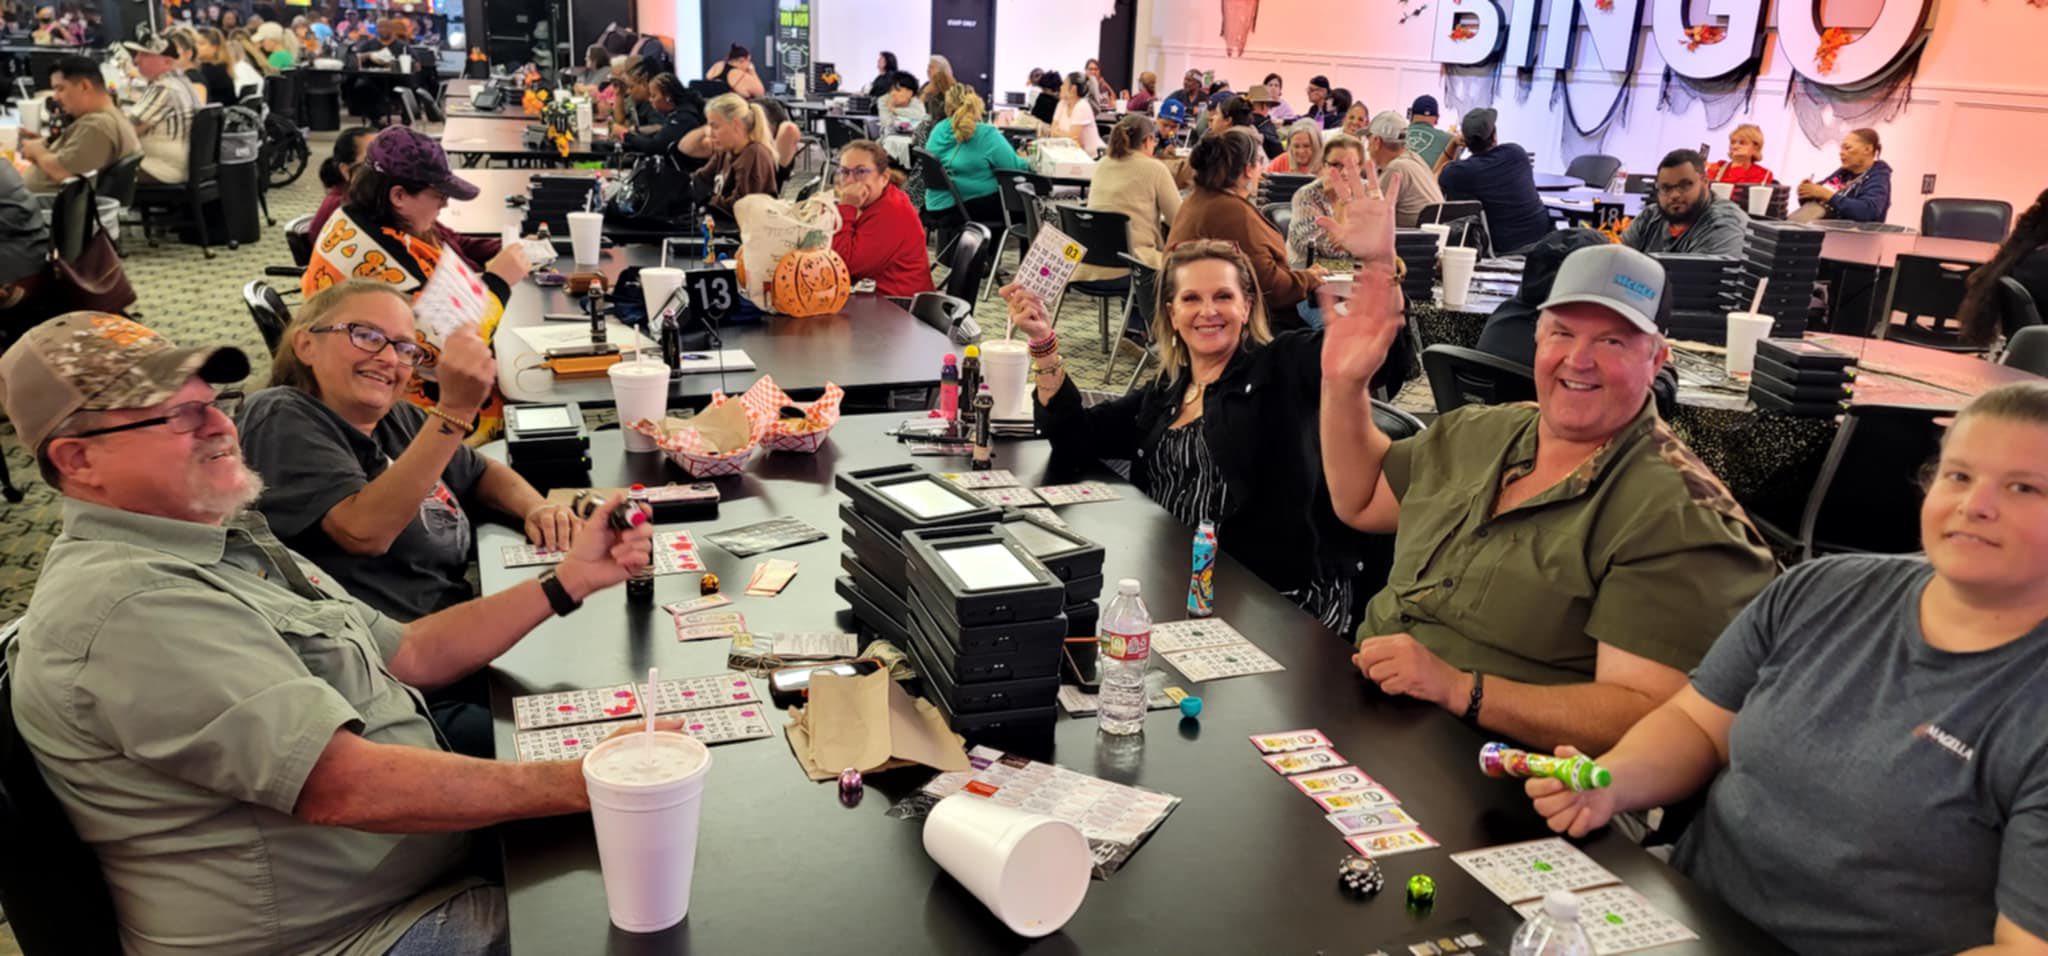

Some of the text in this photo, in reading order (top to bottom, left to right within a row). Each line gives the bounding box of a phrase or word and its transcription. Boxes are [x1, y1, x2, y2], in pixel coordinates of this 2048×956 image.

[1432, 0, 1926, 85] BINGO
[1598, 206, 1619, 227] 18
[1064, 245, 1079, 259] 03
[694, 277, 731, 310] 13
